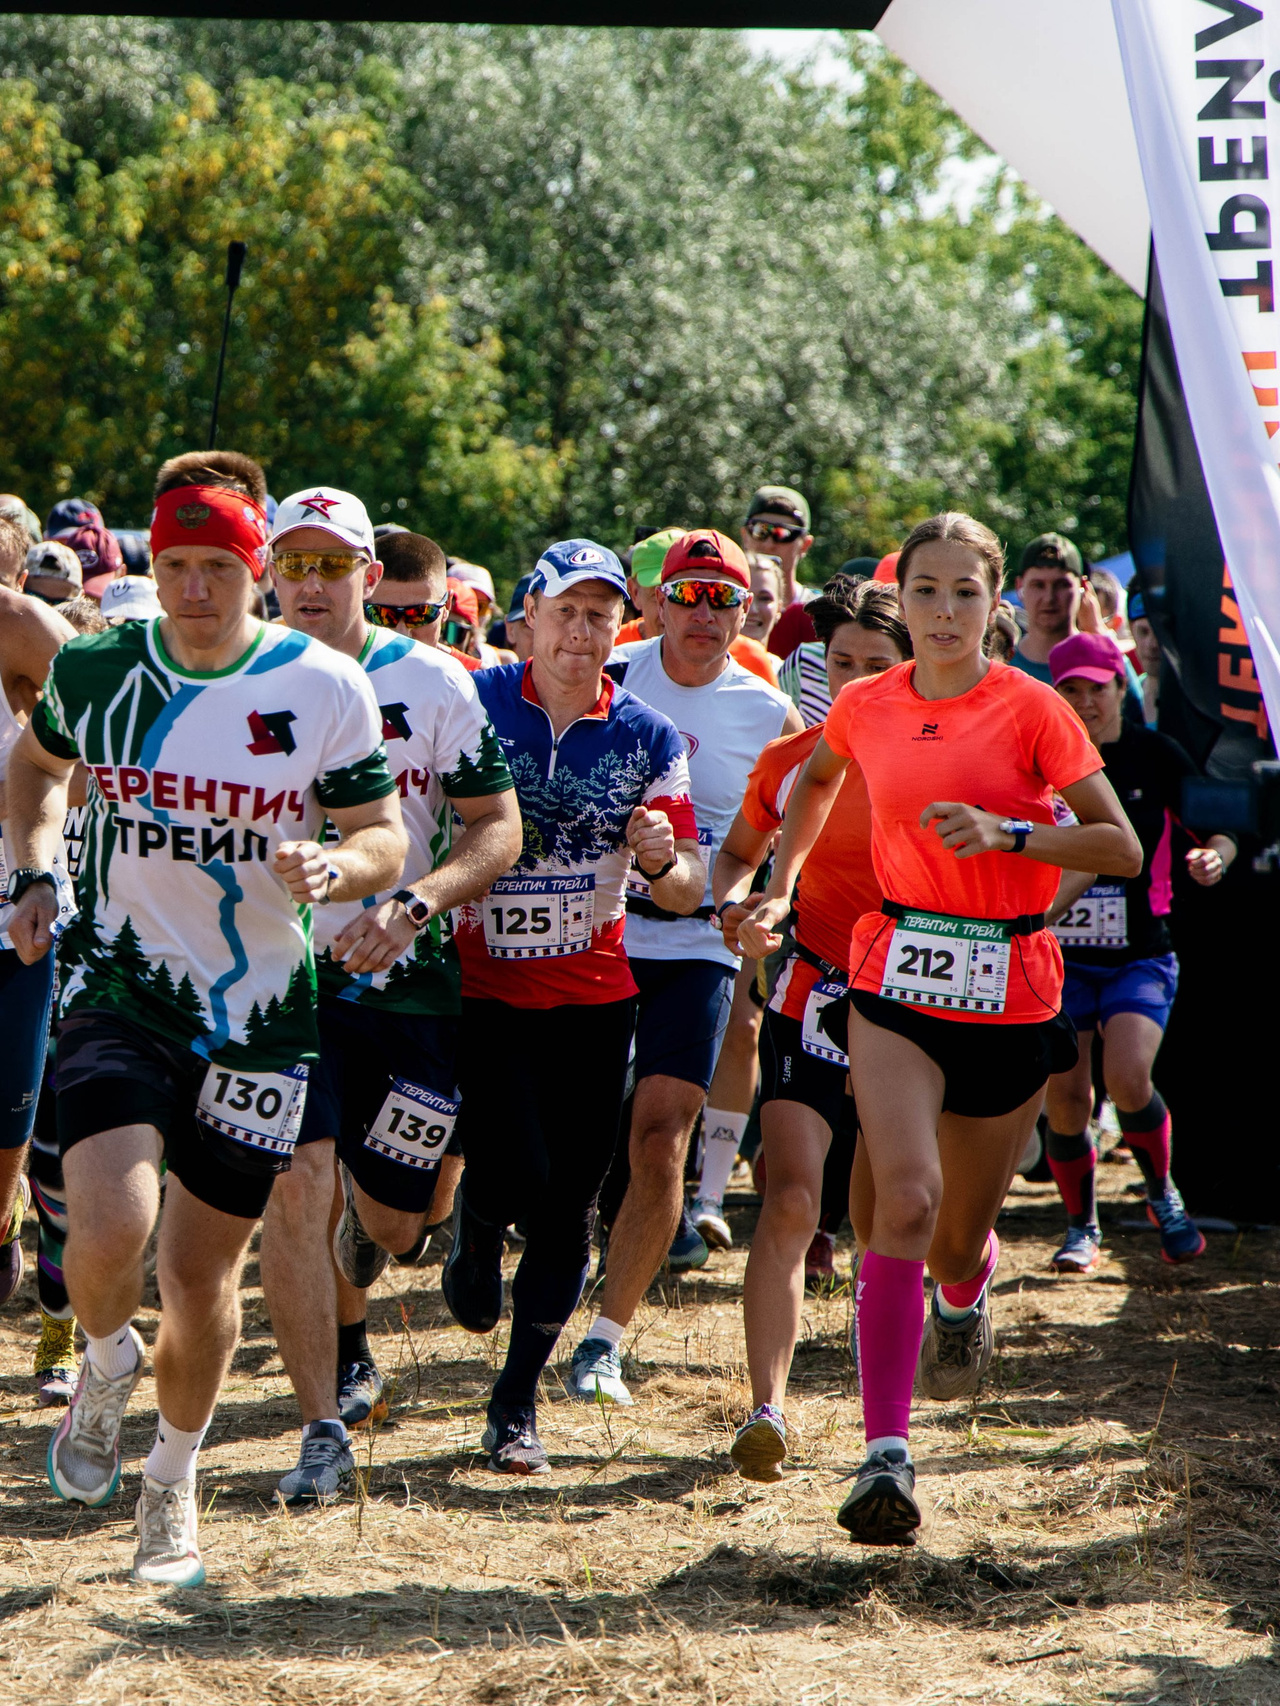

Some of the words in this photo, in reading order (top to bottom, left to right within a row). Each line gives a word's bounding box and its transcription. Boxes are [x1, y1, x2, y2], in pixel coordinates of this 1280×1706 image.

[86, 766, 304, 823] ЕРЕНТИЧ
[113, 816, 269, 864] ТРЕЙЛ
[552, 877, 588, 890] ТРЕЙЛ
[490, 907, 551, 935] 125
[904, 915, 958, 933] ТЕРЕНТИЧ
[963, 924, 1003, 939] ТРЕЙЛ
[1052, 908, 1091, 927] 22
[897, 944, 955, 981] 212
[214, 1072, 282, 1119] 130
[402, 1083, 457, 1113] ТЕРЕНТИЧ
[387, 1107, 446, 1148] 139
